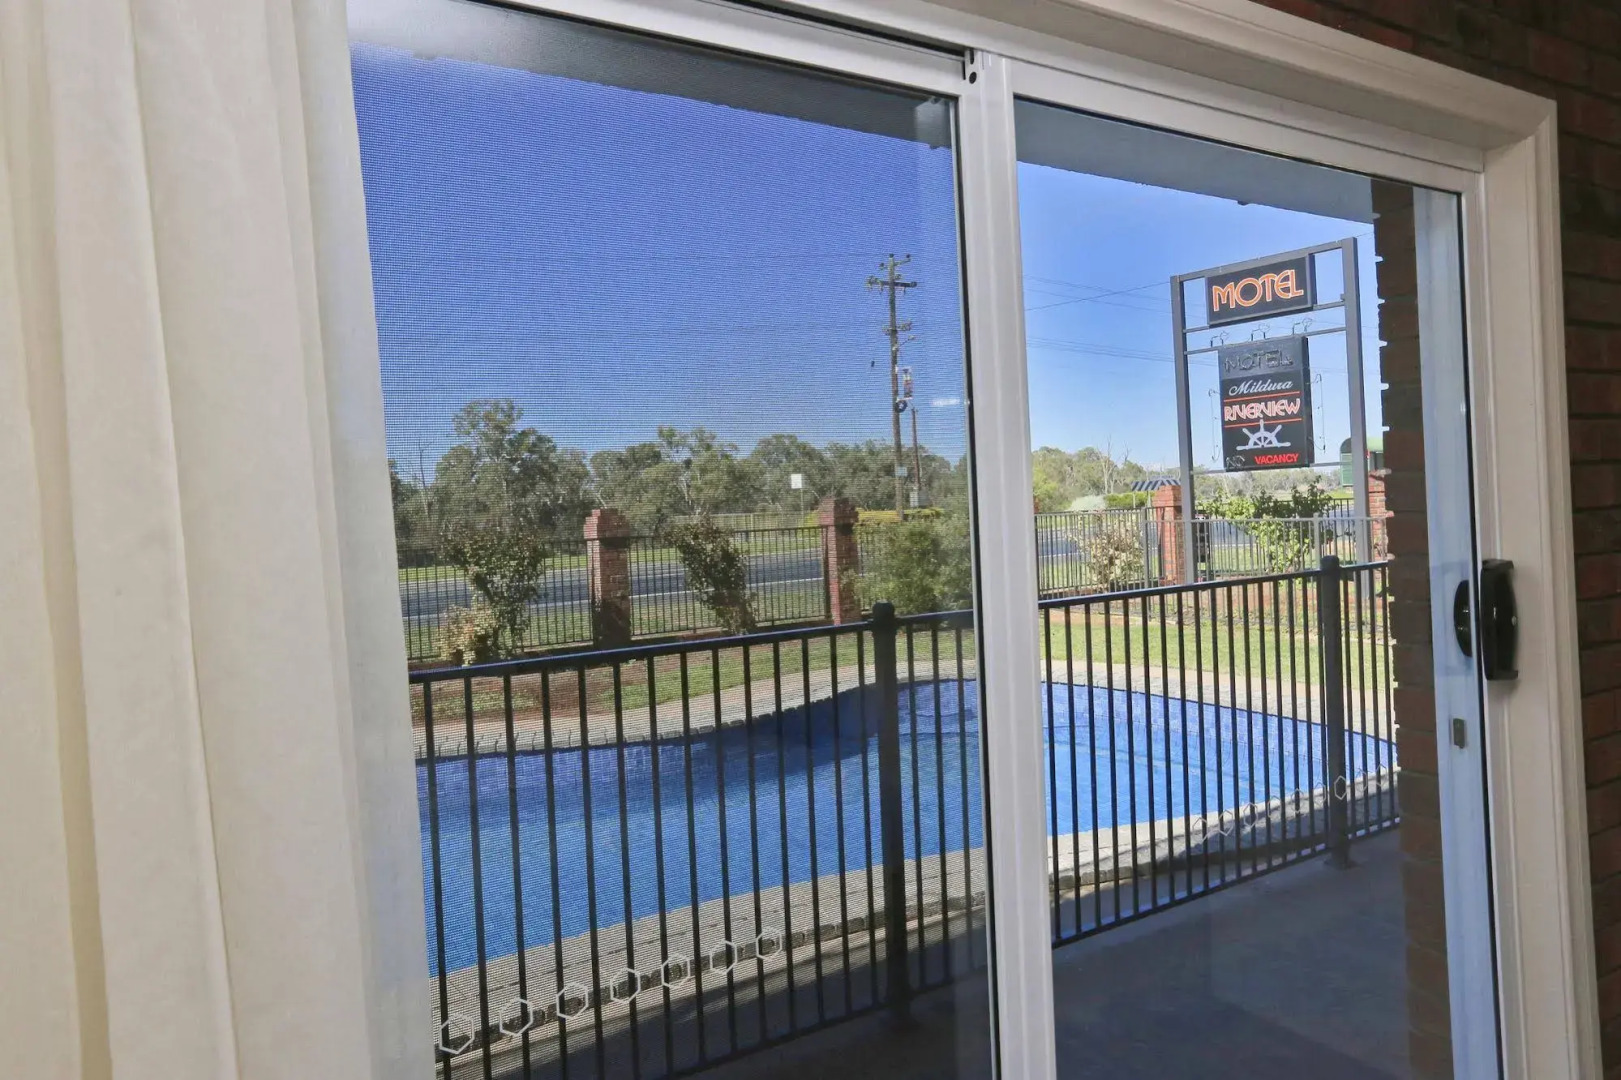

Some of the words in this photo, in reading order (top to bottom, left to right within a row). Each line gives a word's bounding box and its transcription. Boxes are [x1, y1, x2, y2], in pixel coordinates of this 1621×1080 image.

[1212, 269, 1304, 312] MOTEL
[1223, 348, 1295, 373] MOTEL
[1228, 380, 1294, 397] Mildura
[1223, 398, 1301, 422] RIVERVIEW
[1254, 453, 1300, 465] VACANCY
